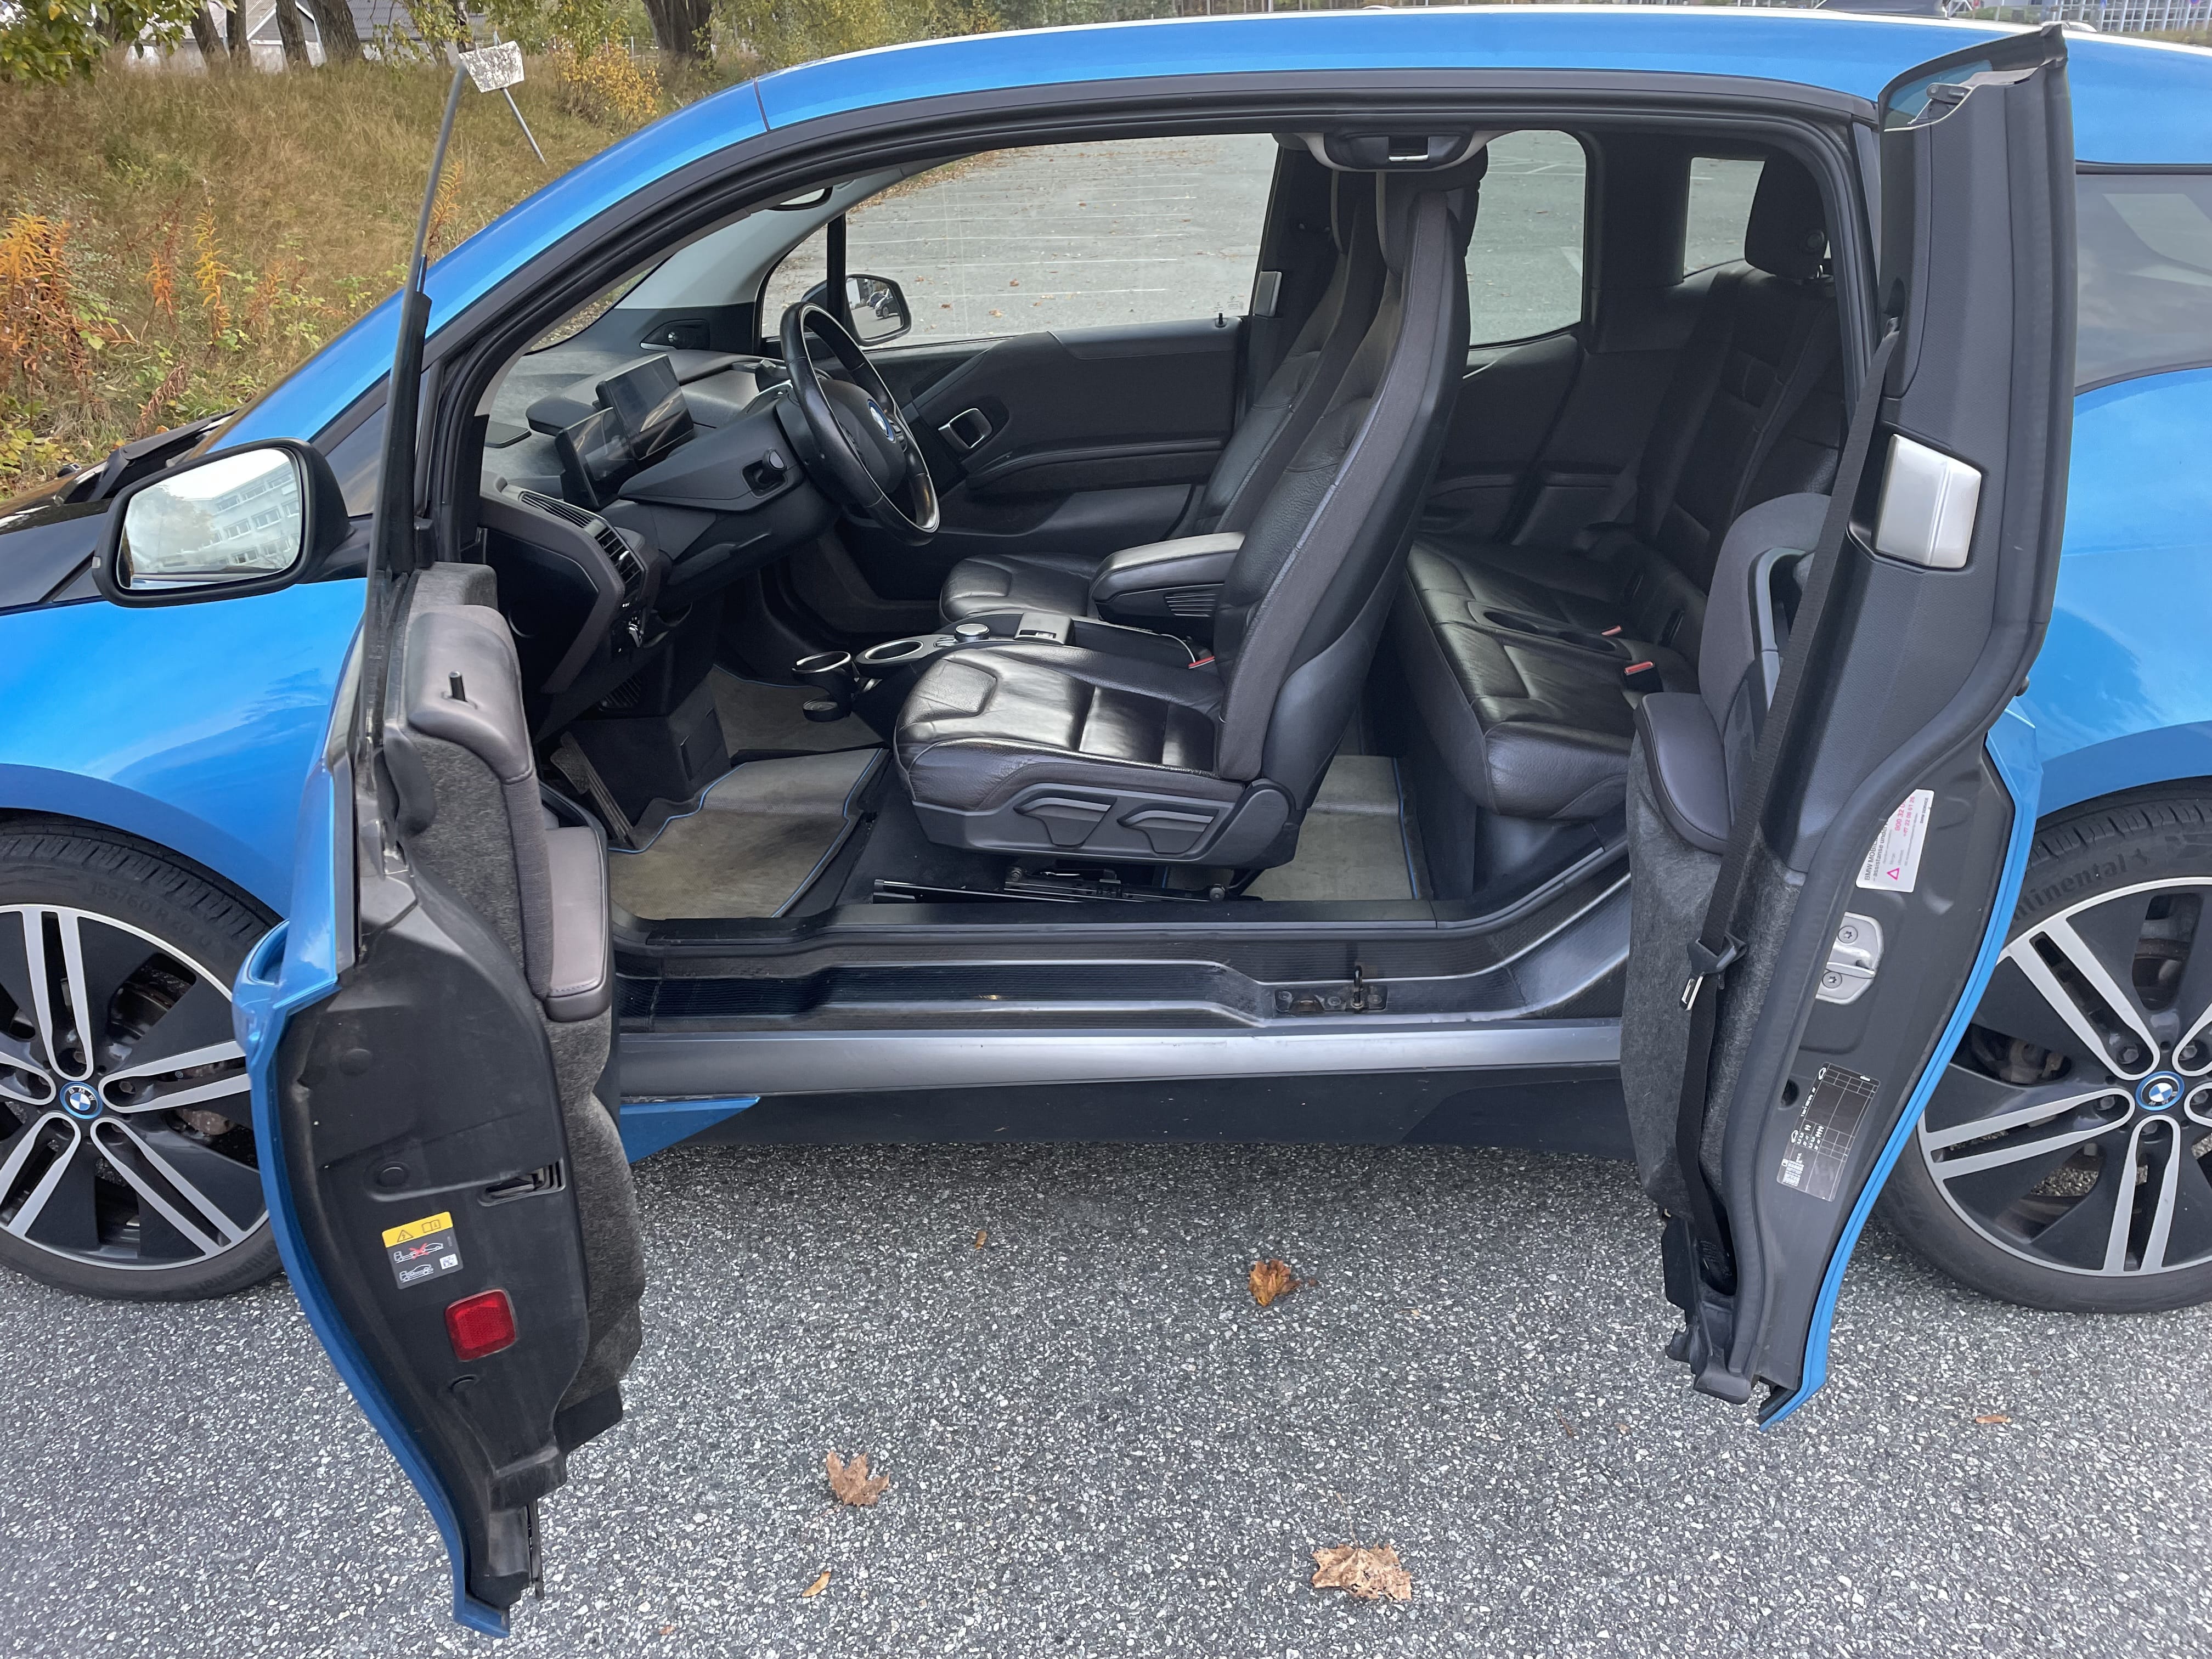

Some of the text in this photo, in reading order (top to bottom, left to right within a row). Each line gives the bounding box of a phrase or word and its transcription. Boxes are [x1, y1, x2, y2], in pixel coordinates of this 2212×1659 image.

[1874, 845, 1883, 877] assistanse
[2013, 853, 2129, 922] ntinental
[68, 1088, 95, 1102] BMW
